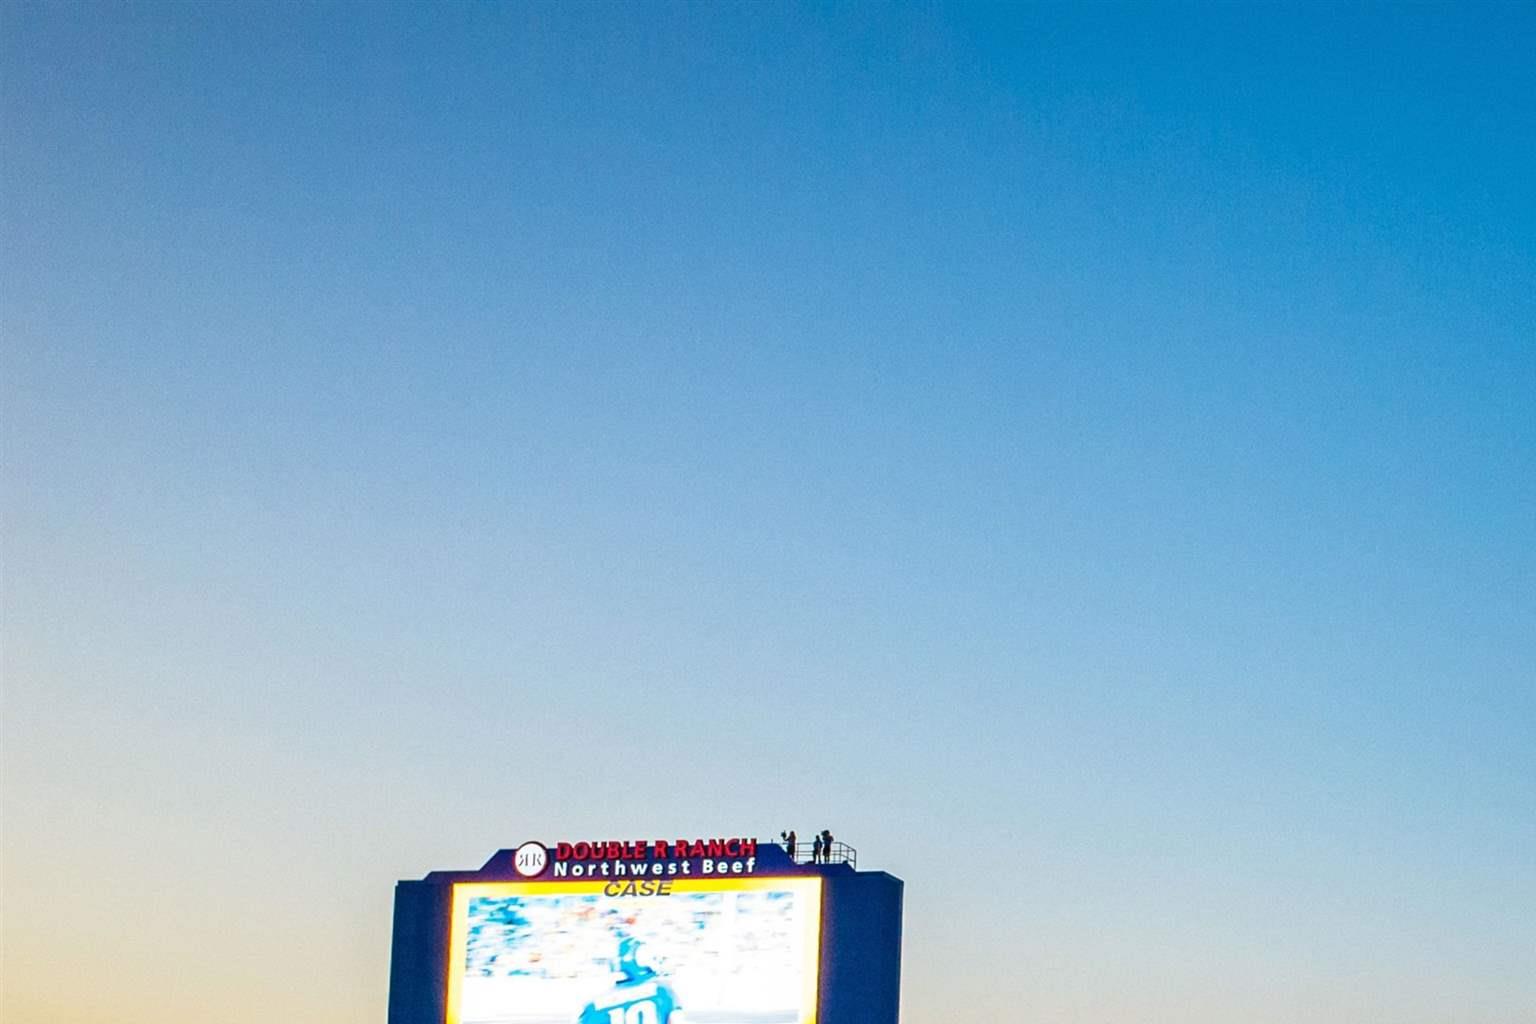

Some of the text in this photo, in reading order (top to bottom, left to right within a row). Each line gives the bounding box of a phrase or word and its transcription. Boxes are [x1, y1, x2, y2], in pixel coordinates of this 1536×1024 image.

[556, 838, 757, 861] DOUBLE R RANCH
[554, 857, 756, 877] Northwest Beef
[603, 879, 674, 897] CASE
